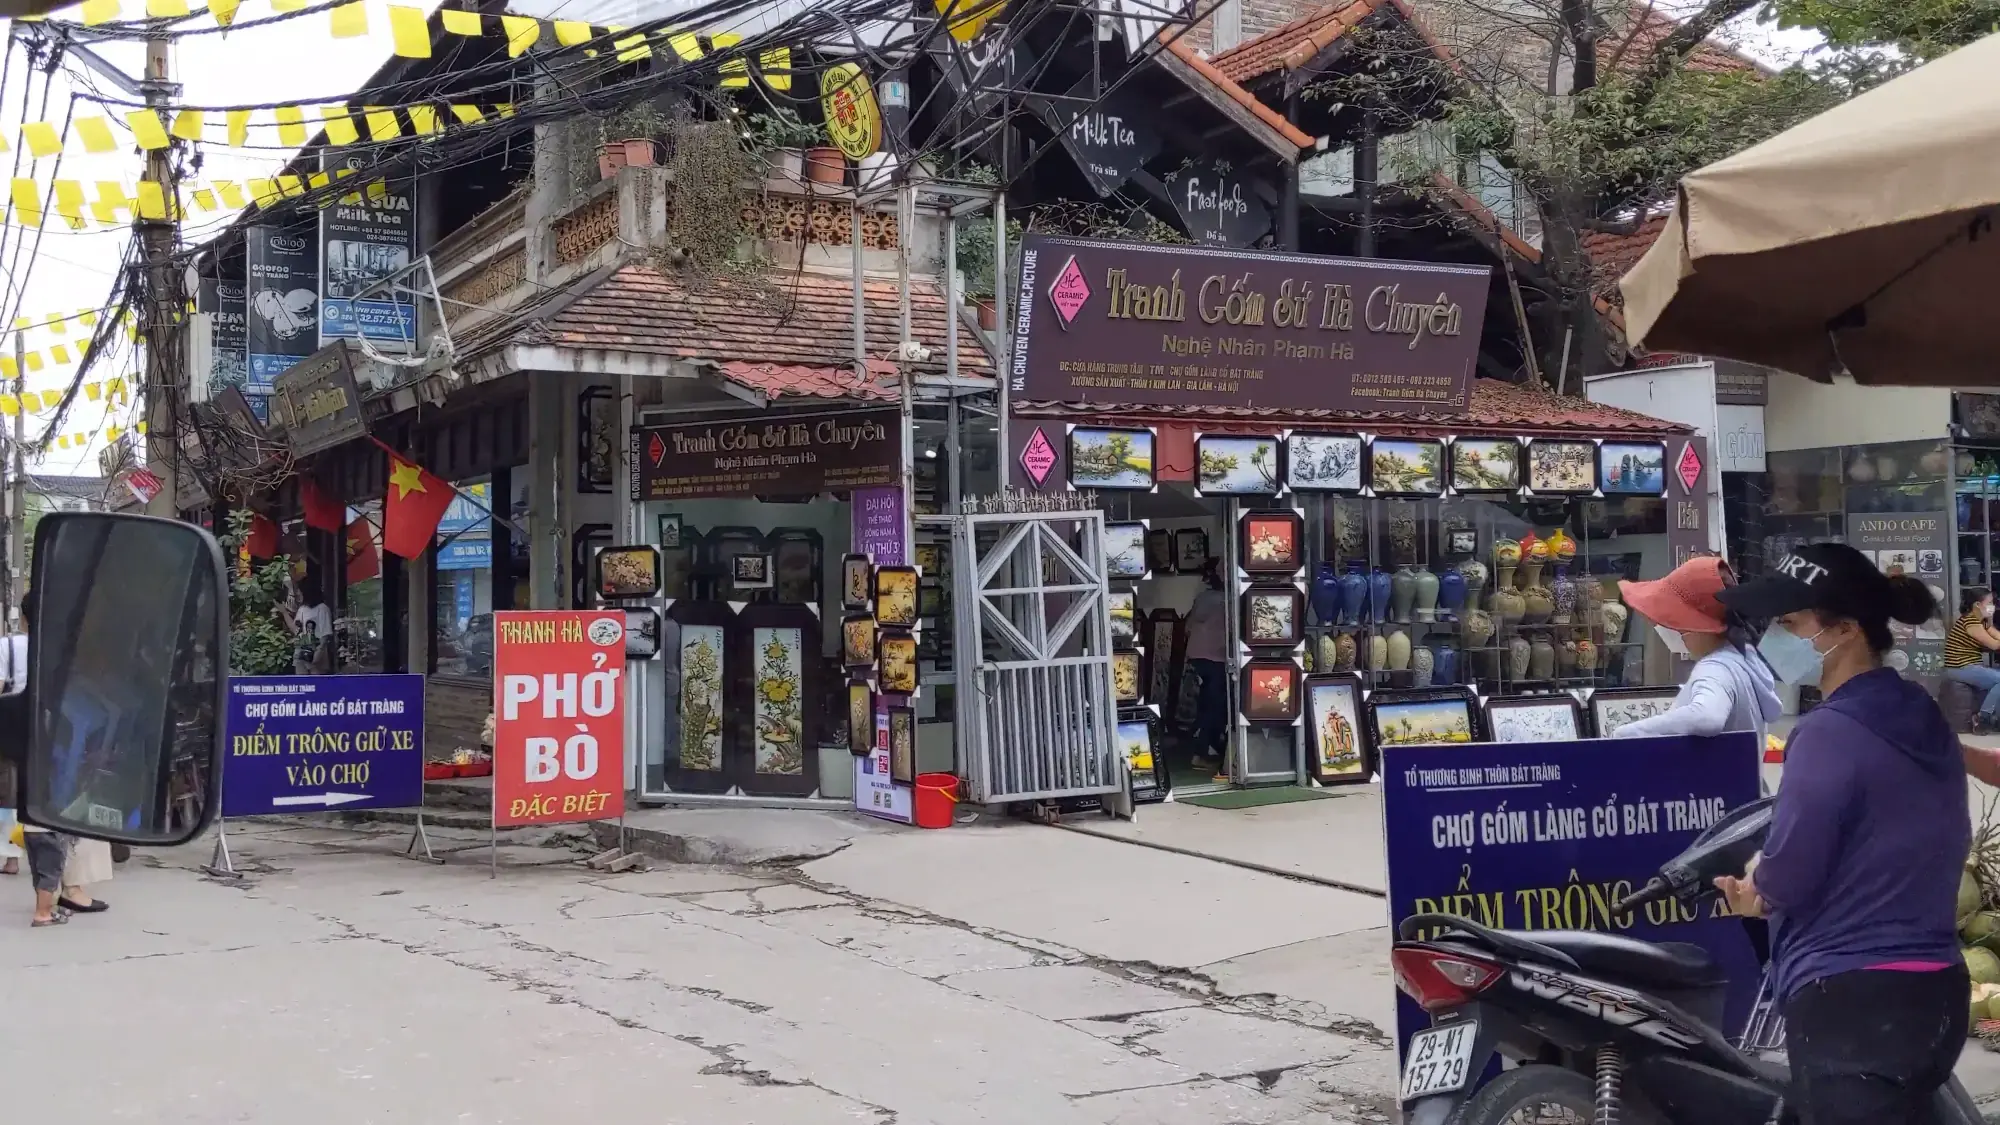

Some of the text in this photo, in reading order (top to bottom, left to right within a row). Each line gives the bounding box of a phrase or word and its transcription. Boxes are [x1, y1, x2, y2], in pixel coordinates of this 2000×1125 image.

[1072, 112, 1135, 147] Milk Tea
[337, 208, 401, 224] Milk Tea
[1058, 291, 1084, 300] CERAMIC
[1107, 268, 1462, 350] Tranh Gốm Sứ Hà Chuyên
[1014, 337, 1028, 375] CHUYEN
[1162, 334, 1354, 362] Nghệ Nhân Phạm Hà
[1012, 377, 1024, 391] HA
[1087, 362, 1106, 374] HÀNG
[1107, 363, 1128, 374] TRUNG
[1130, 362, 1144, 374] TÂM
[1184, 364, 1198, 376] GỐM
[1230, 367, 1241, 379] BÁT
[1243, 368, 1264, 380] TRÀNG
[1096, 376, 1108, 388] SẢN
[1109, 376, 1126, 388] XUẤT
[1130, 377, 1147, 389] THÔN
[1153, 379, 1166, 389] KIM
[1167, 380, 1181, 390] LAN
[1186, 380, 1197, 391] GIA
[1228, 382, 1239, 394] NỘI
[1382, 388, 1400, 397] Tranh
[672, 419, 886, 454] Tranh Gốm Sứ Hà Chuyên
[715, 452, 817, 470] Nghệ Nhân Phạm Hà
[866, 495, 894, 511] ĐẠI HỘI
[1677, 501, 1699, 529] Bán
[879, 514, 892, 524] THAO
[880, 527, 892, 537] NAM
[1858, 518, 1937, 532] ANDO CAFE
[876, 540, 892, 555] THỨ
[1911, 534, 1931, 543] Food
[1775, 552, 1829, 586] RT
[500, 620, 556, 644] THANH
[560, 615, 584, 643] HÀ
[503, 652, 621, 721] PHỞ
[245, 697, 404, 720] CHỢ GỐM LÀNG CỔ BÁT TRÀNG
[233, 723, 414, 756] ĐIỂM TRÔNG GIỮ XE
[525, 723, 598, 783] BÒ
[286, 759, 370, 788] VÀO CHỢ
[1404, 762, 1561, 787] TỔ THƯƠNG BINH THÔN BÁT TRÀNG
[510, 789, 612, 820] ĐẶC BIỆT
[1432, 793, 1726, 854] CHỢ GỐM LÀNG CỔ BÁT TRÀNG
[1515, 868, 1634, 931] TRÔNG
[1415, 1026, 1465, 1063] 29-N1
[1406, 1057, 1464, 1095] 157.29
